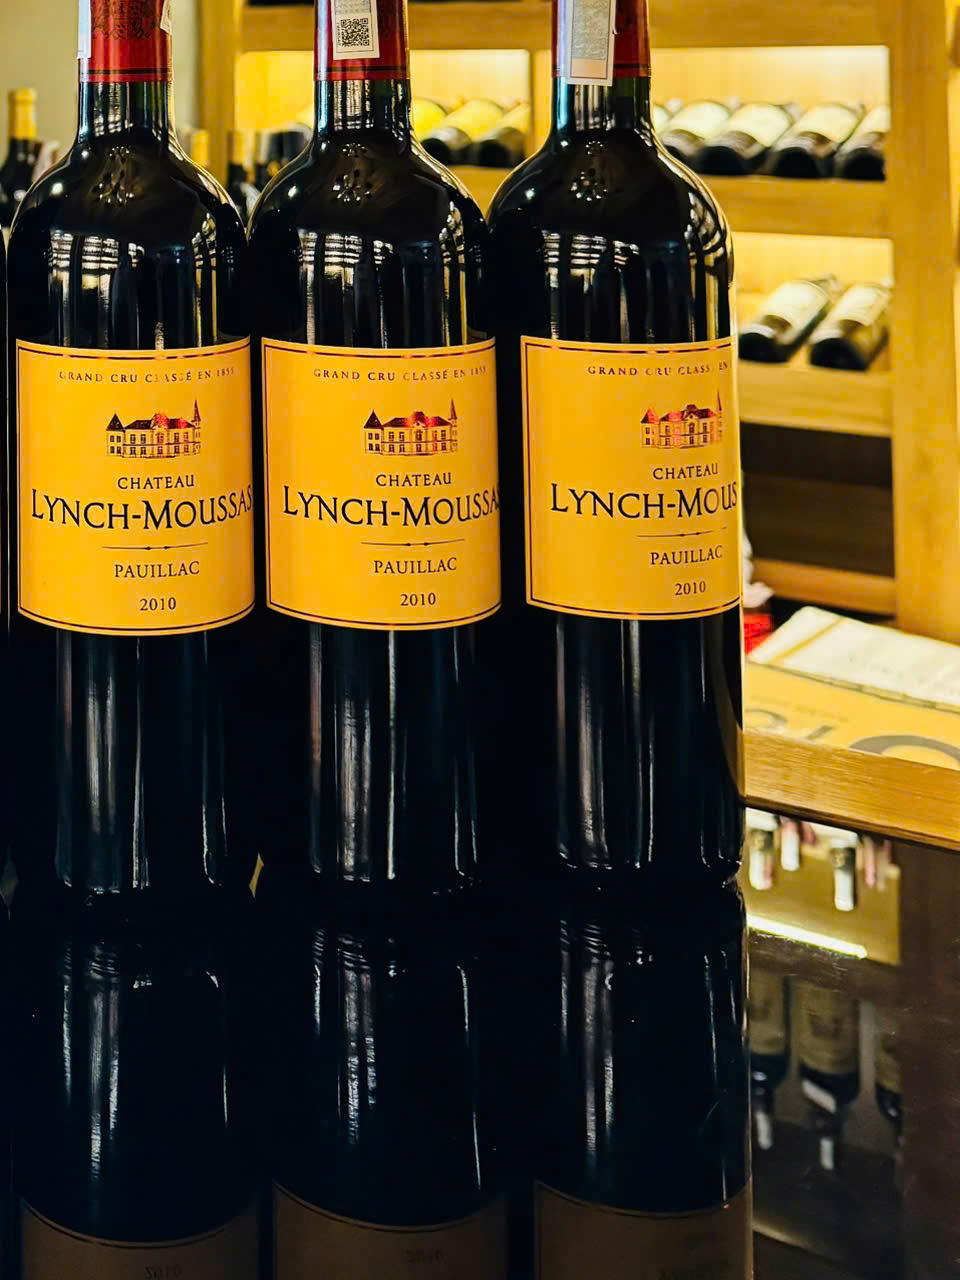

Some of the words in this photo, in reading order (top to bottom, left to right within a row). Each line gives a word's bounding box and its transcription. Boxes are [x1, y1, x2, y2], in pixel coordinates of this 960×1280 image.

[111, 372, 137, 383] CRU
[145, 371, 192, 383] CASÉ
[198, 370, 211, 380] EN
[313, 368, 360, 380] GRAND
[368, 371, 395, 381] CRU
[403, 369, 448, 380] CLASSÉ
[454, 368, 465, 378] EN
[588, 365, 638, 376] GRAND
[646, 367, 672, 376] CRU
[678, 364, 711, 375] CLASS
[652, 462, 718, 480] CHATEAU
[117, 475, 195, 490] CHATEAU
[376, 472, 452, 487] CHATEAU
[31, 484, 253, 530] LYNCH-MOUSSAS
[650, 544, 723, 565] PAUILLAC
[114, 560, 200, 578] PAUILLAC
[374, 557, 457, 575] PAUILLAC
[675, 581, 706, 596] 2010
[140, 597, 177, 611] 2010
[400, 592, 436, 607] 2010
